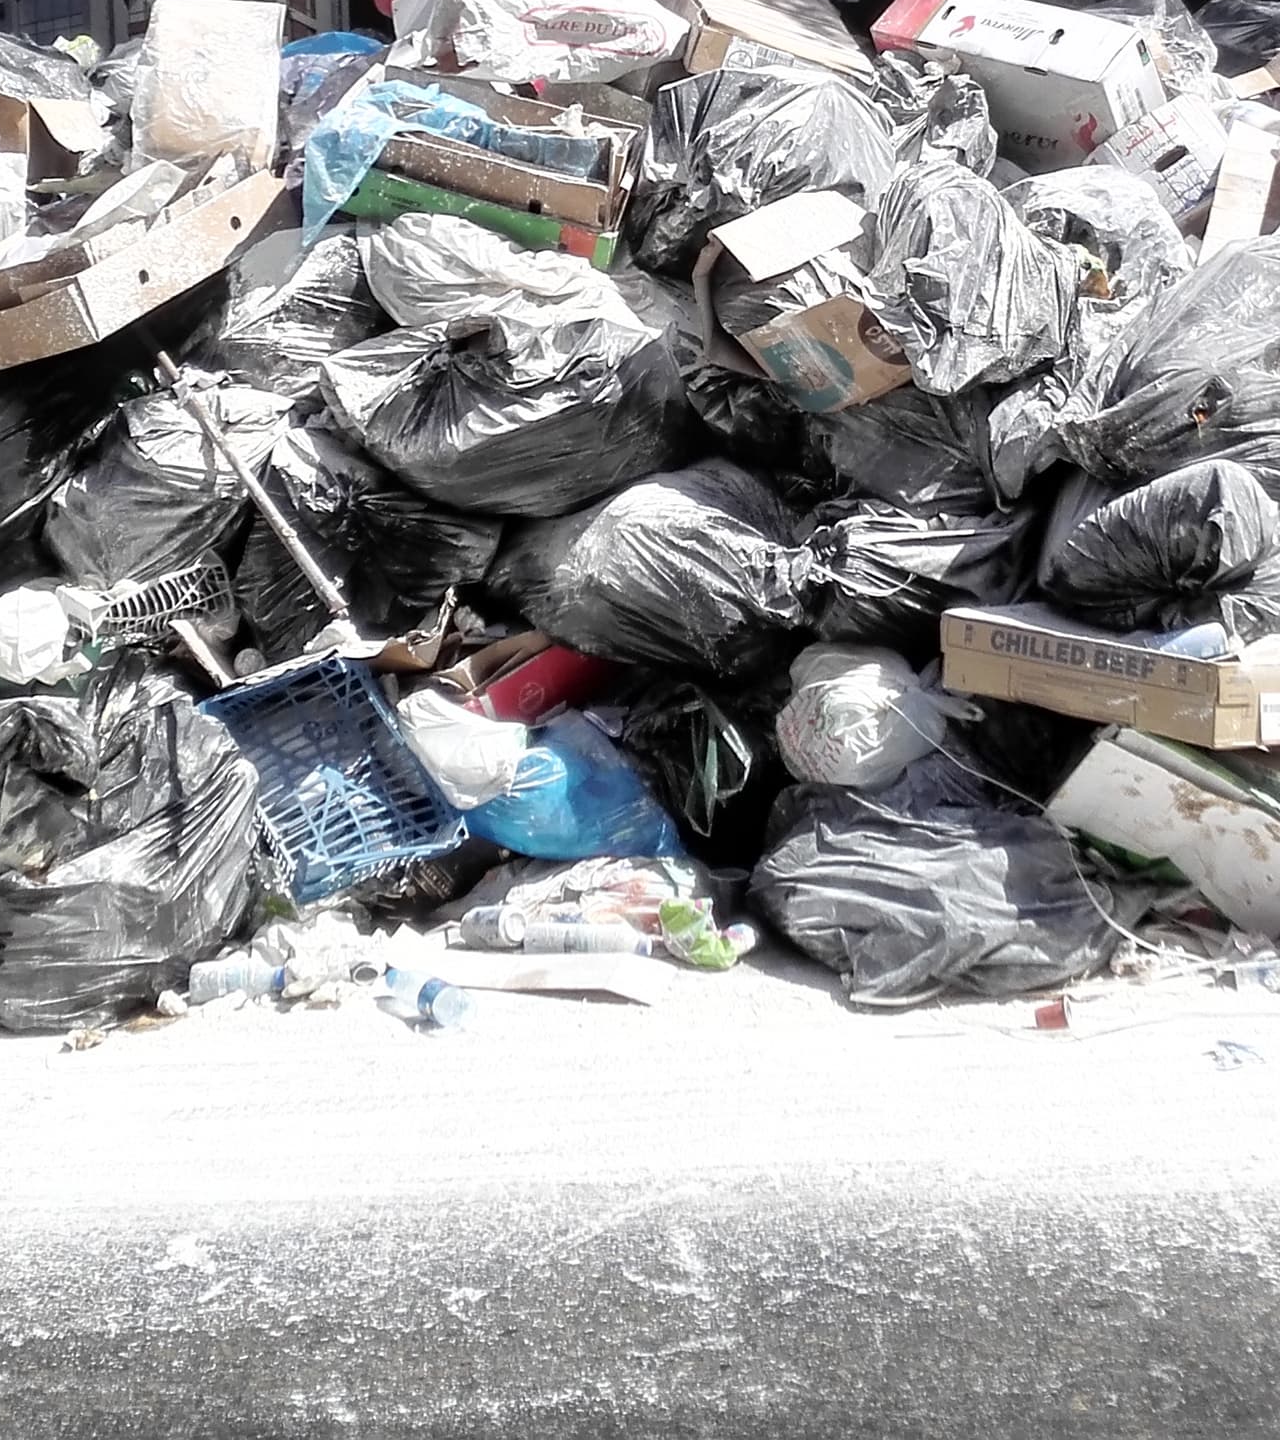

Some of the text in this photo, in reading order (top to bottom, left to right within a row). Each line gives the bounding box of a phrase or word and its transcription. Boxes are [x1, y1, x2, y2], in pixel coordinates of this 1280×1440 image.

[585, 22, 609, 35] DU
[990, 629, 1087, 666] CHILLED
[1093, 649, 1157, 679] BEEF
